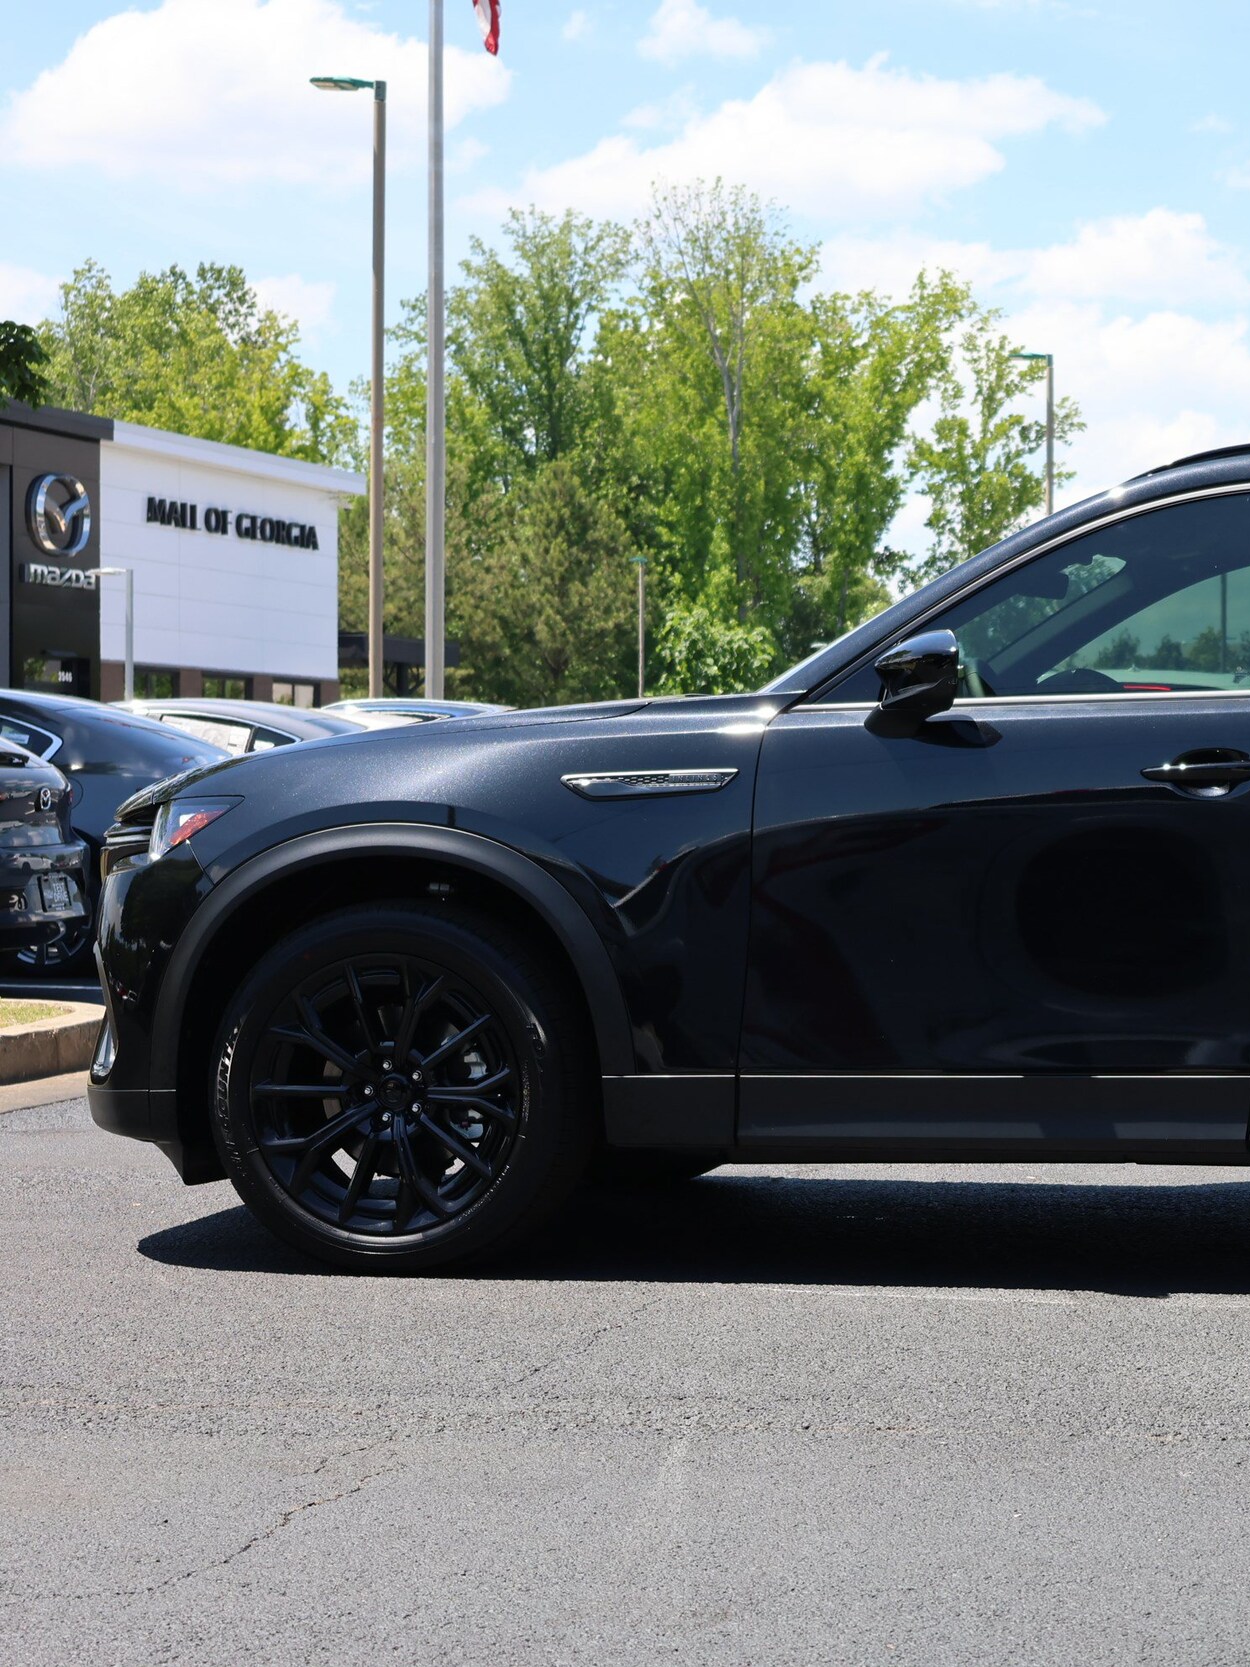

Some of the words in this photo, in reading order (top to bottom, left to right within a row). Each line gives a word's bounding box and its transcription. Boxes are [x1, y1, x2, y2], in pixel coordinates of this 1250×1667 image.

[146, 496, 201, 531] MALL
[204, 507, 233, 535] OF
[235, 513, 319, 551] GEORGIA
